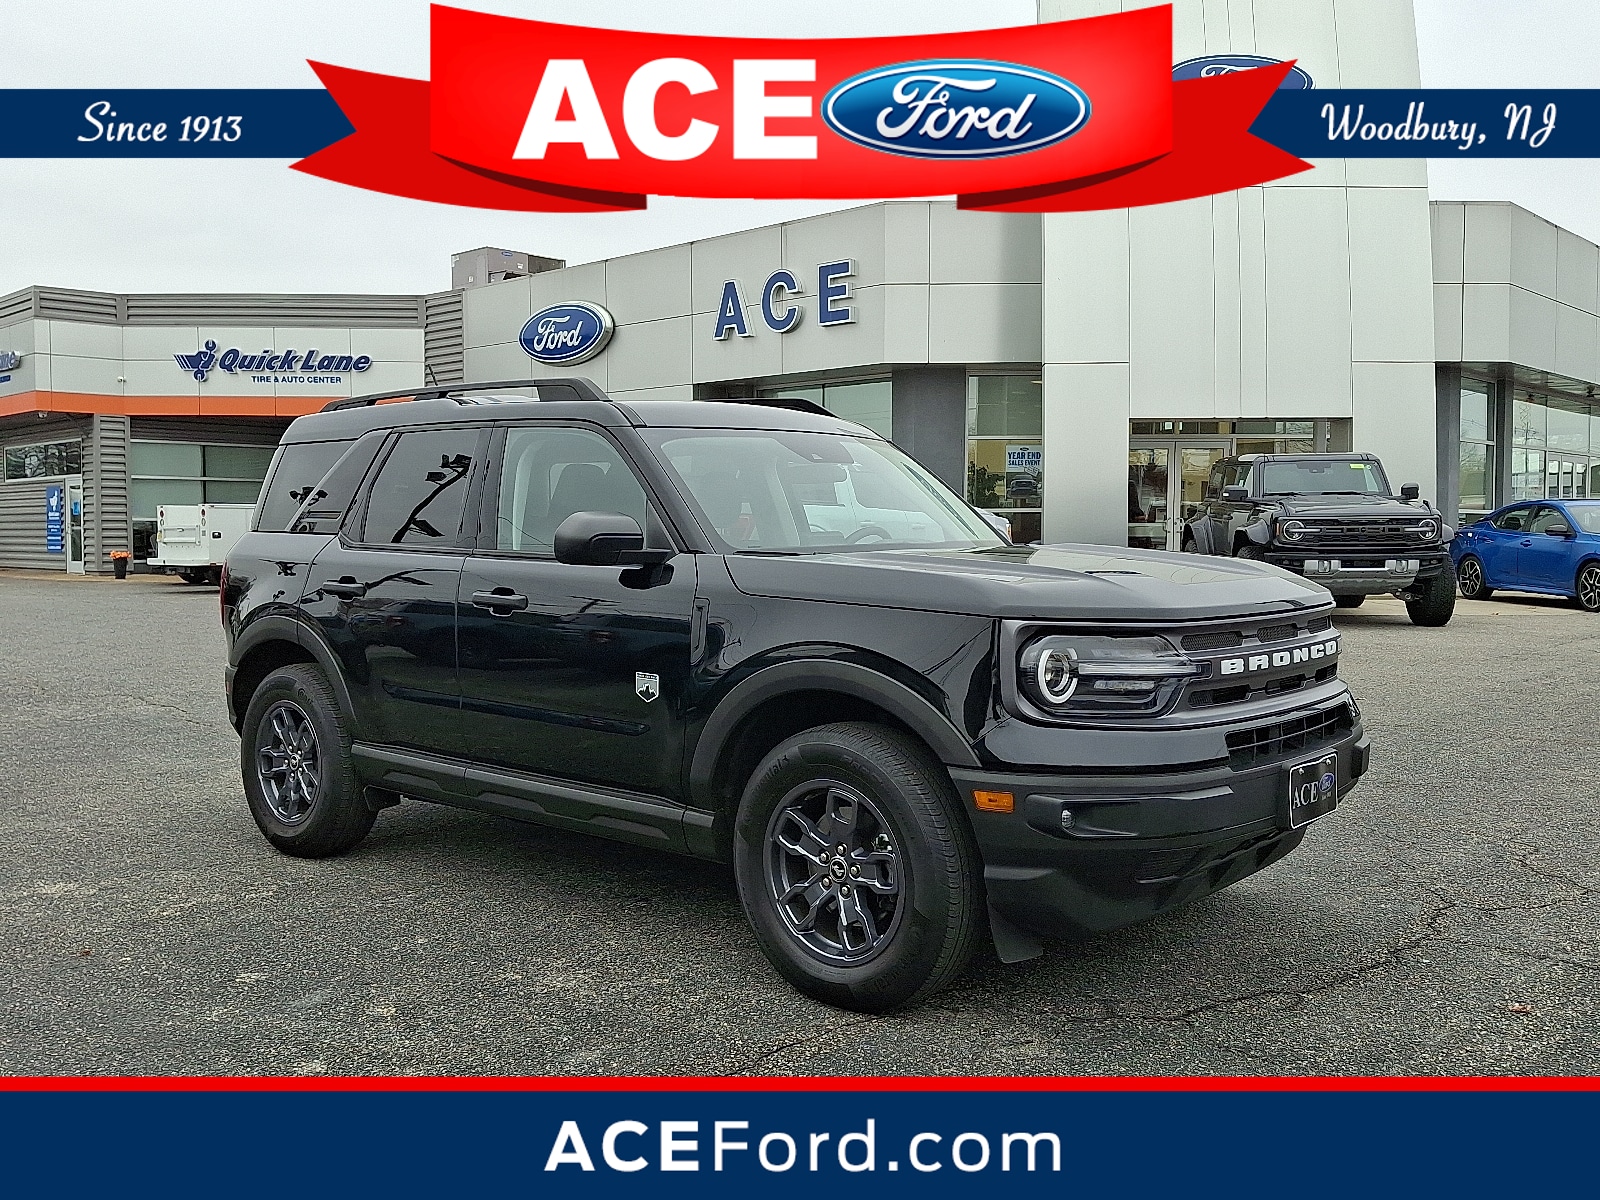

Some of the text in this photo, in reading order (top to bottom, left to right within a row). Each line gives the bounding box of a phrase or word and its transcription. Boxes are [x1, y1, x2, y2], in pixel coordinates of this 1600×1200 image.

[712, 259, 855, 340] ACE
[532, 314, 583, 352] Ford
[218, 348, 372, 374] Quick Lane
[251, 375, 342, 384] TIRE & AUTO CENTER
[1008, 451, 1041, 460] YEAR END
[1220, 640, 1337, 675] BRONCO
[1292, 781, 1319, 810] ACE
